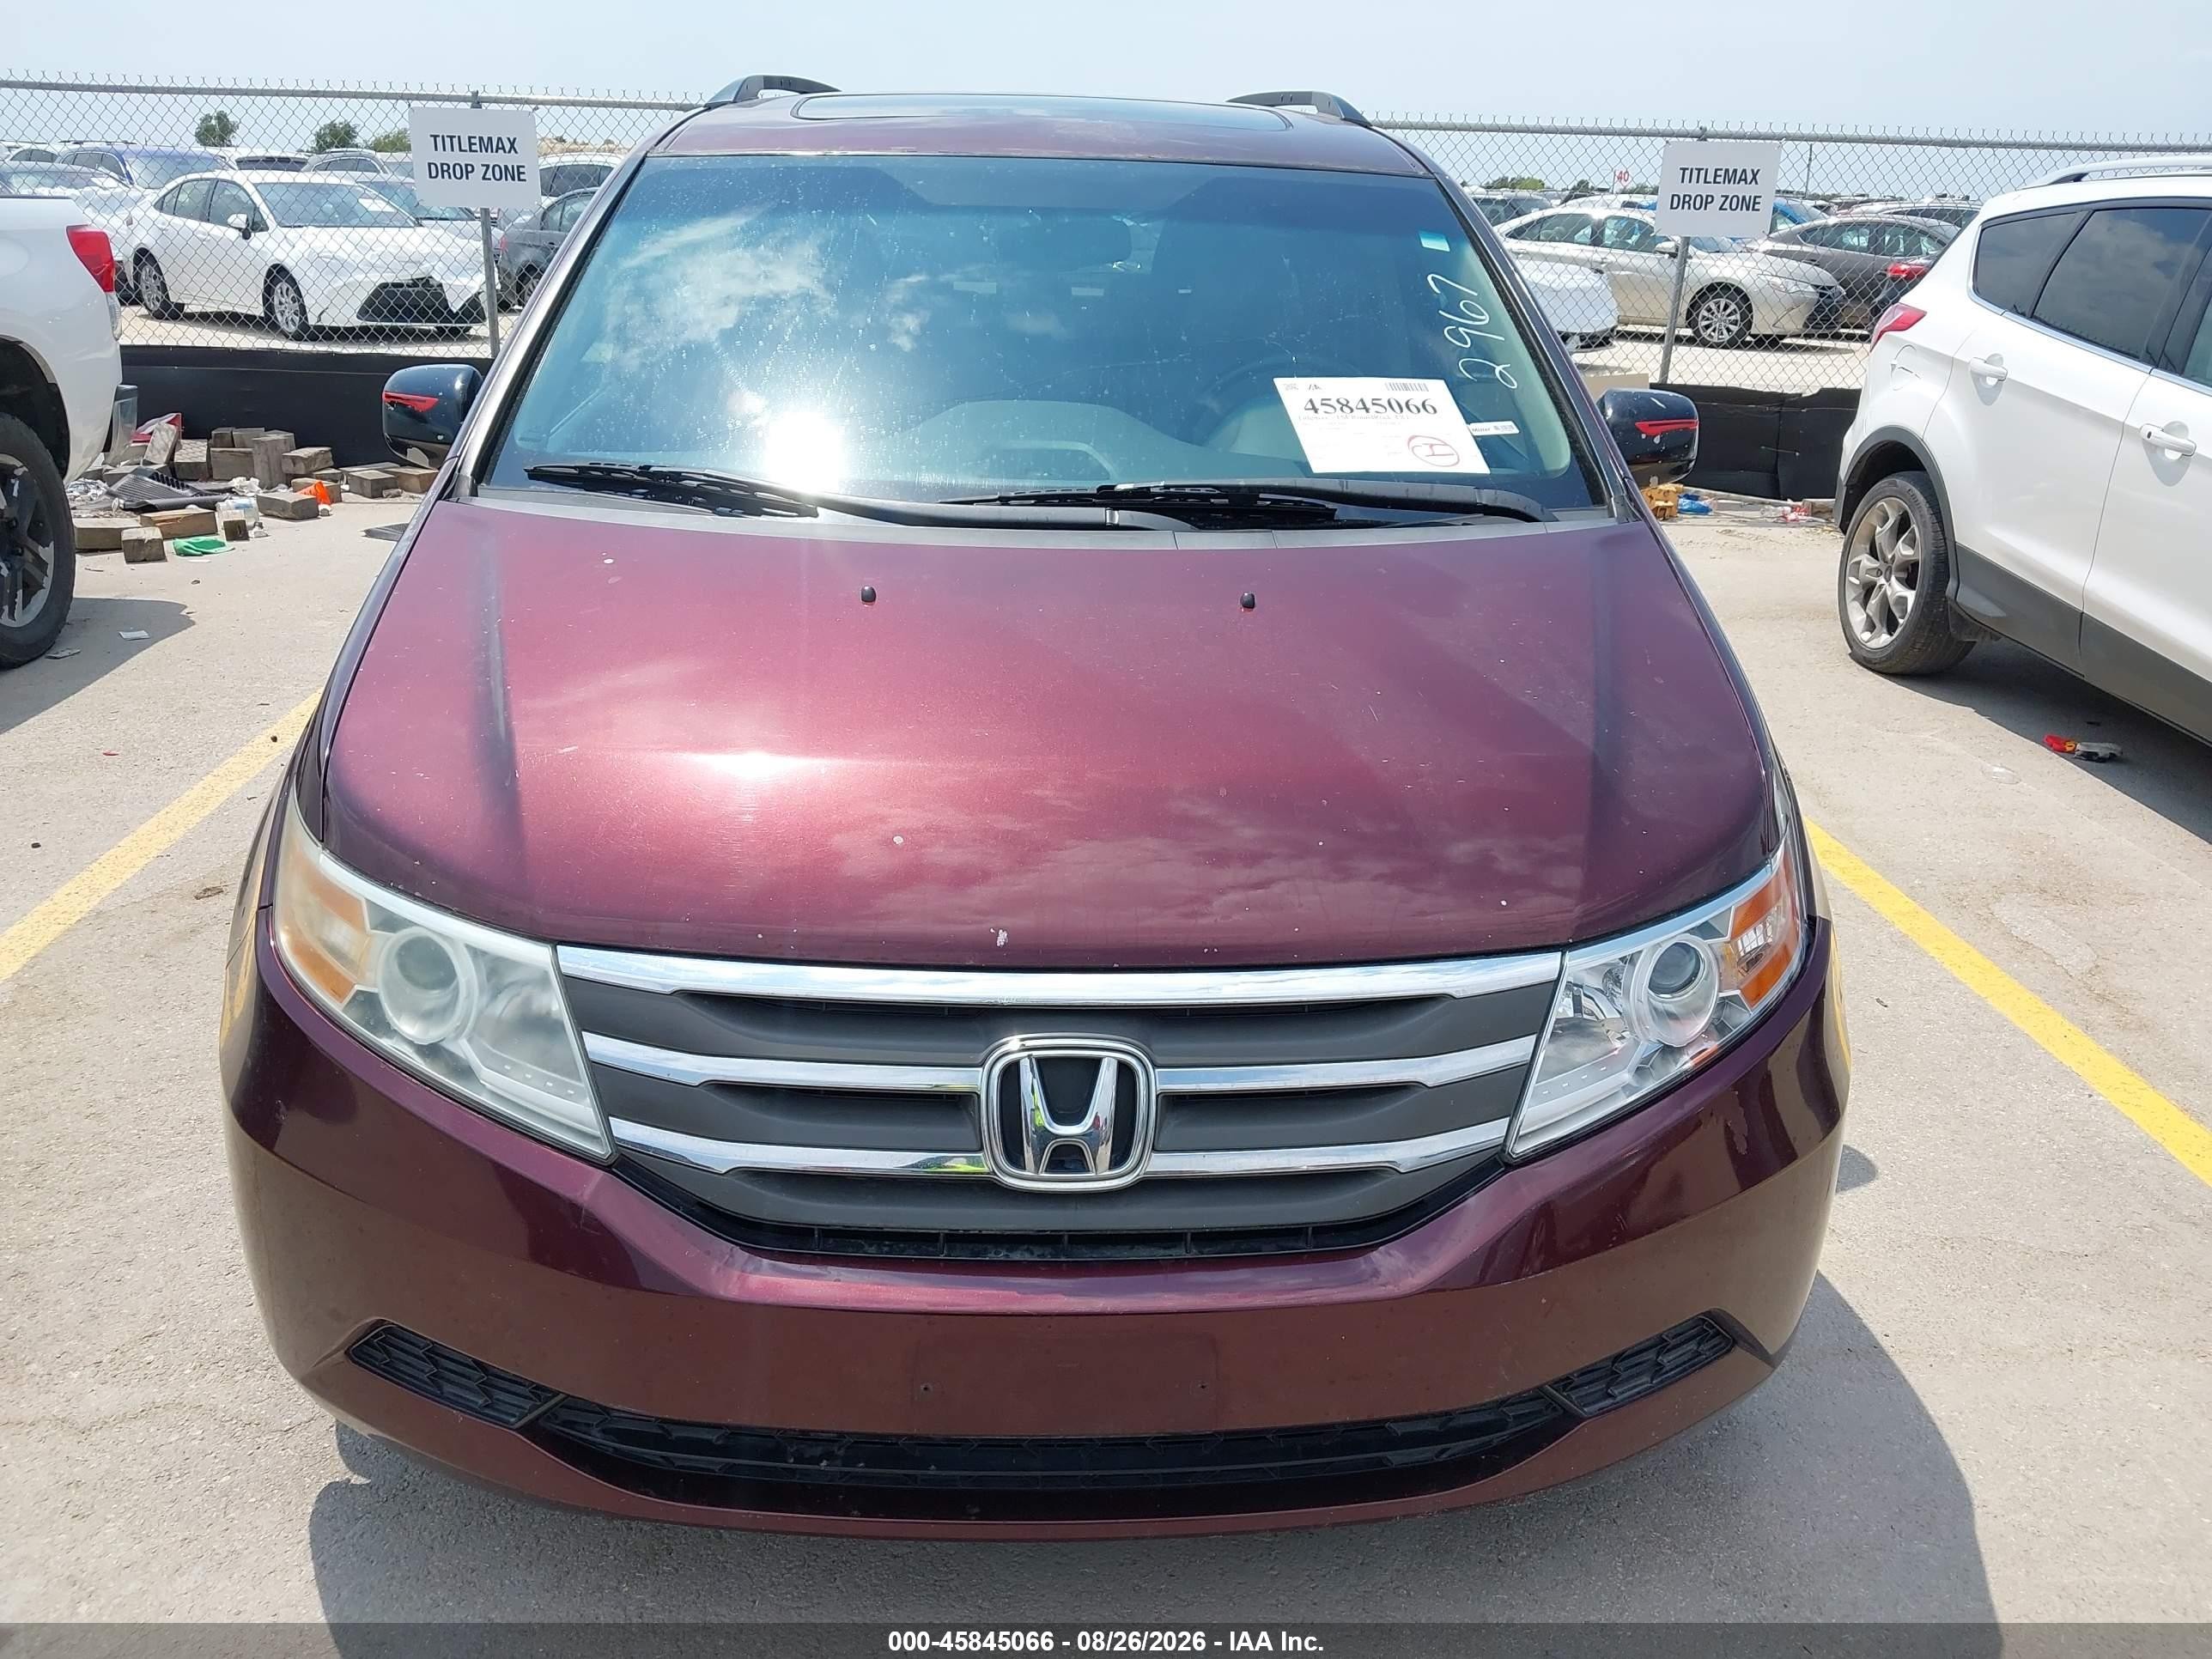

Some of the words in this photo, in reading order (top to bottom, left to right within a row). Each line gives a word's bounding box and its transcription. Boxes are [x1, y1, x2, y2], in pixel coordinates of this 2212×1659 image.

[429, 134, 519, 155] TITLEMAX
[427, 161, 475, 180] DROP
[480, 163, 527, 182] ZONE
[1616, 170, 1630, 182] 40
[1679, 167, 1760, 185] TITLEMAX
[1669, 193, 1715, 211] DROP
[1718, 194, 1762, 212] ZONE
[1426, 273, 1518, 389] 2967
[1304, 398, 1437, 414] 45845066
